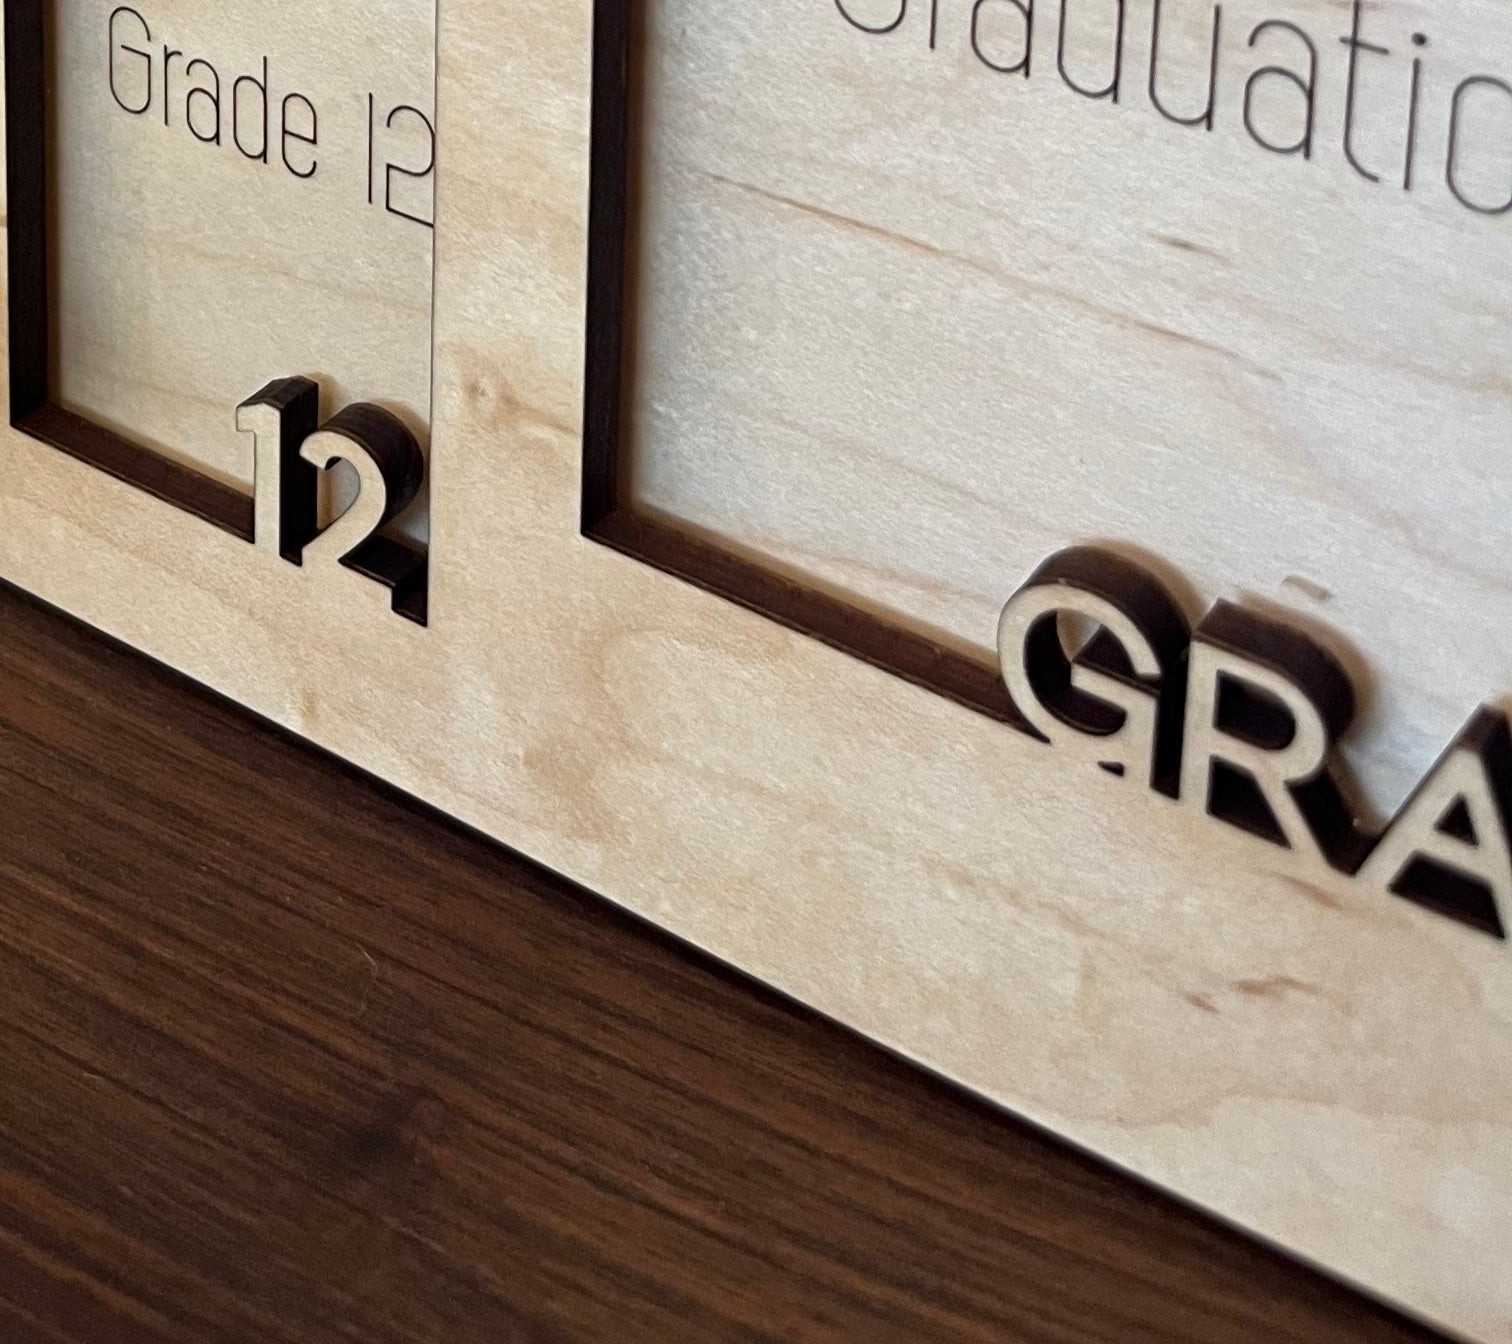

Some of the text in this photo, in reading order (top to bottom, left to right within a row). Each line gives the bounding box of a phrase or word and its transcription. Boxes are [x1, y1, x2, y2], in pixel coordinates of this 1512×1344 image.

[109, 6, 436, 228] Grade 12
[236, 392, 410, 612] 12
[997, 572, 1512, 940] GRA
